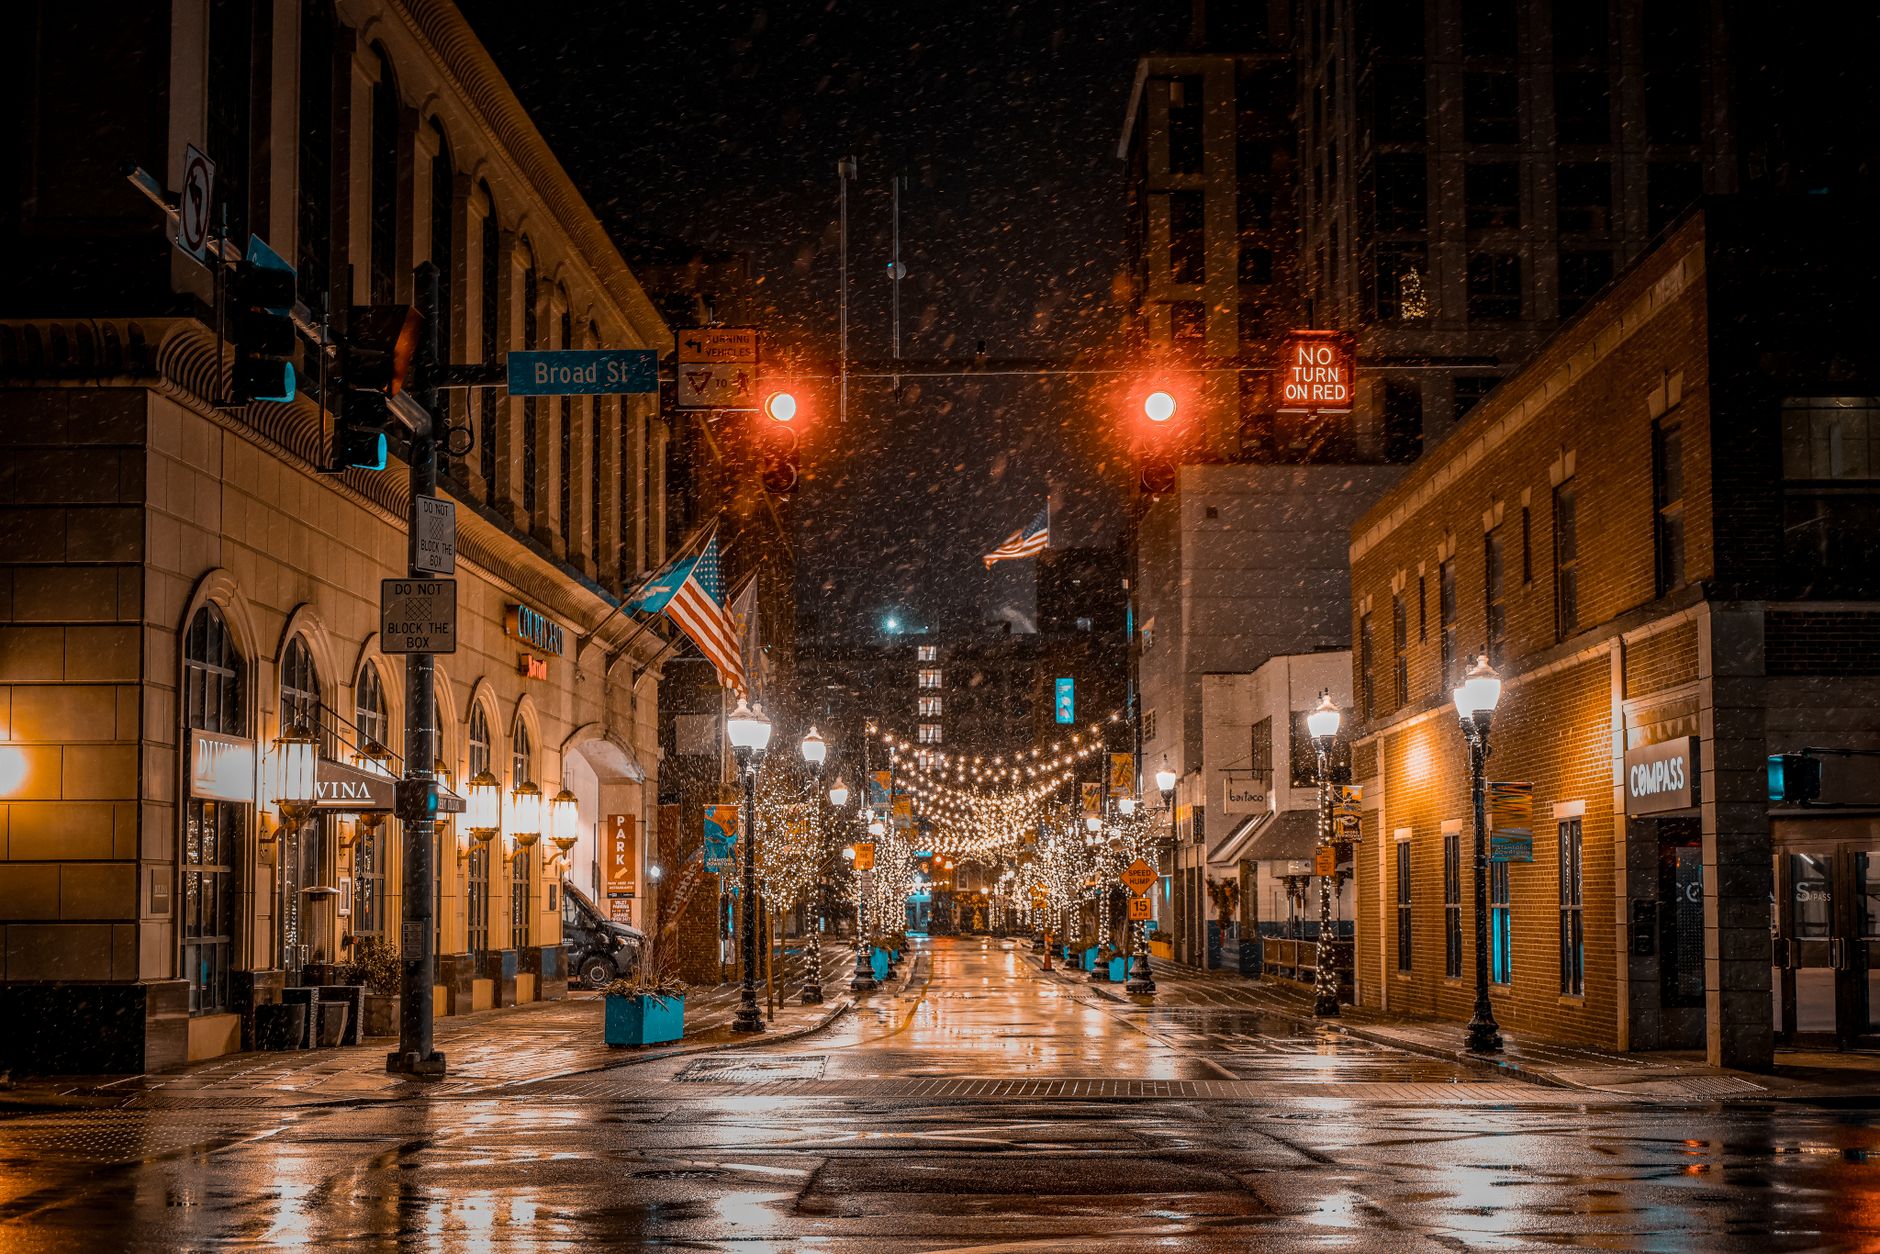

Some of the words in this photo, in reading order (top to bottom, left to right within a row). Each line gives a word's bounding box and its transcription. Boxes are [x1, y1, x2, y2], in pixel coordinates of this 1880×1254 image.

[706, 334, 750, 344] TURNING
[705, 347, 751, 357] VEHICLES
[1298, 347, 1332, 365] NO
[534, 361, 597, 384] Broad
[607, 360, 629, 383] St
[1292, 367, 1339, 382] TURN
[715, 378, 728, 388] TO
[1285, 384, 1308, 400] ON
[1313, 384, 1346, 400] RED
[423, 501, 433, 513] DO
[435, 503, 449, 517] NOT
[420, 539, 440, 553] BLOCK
[442, 543, 453, 556] THE
[429, 554, 442, 568] BOX
[394, 583, 412, 595] DO
[417, 583, 443, 595] NOT
[387, 622, 423, 634] BLOCK
[428, 622, 449, 634] THE
[406, 637, 430, 649] BOX
[1630, 756, 1685, 798] COMPASS
[1229, 789, 1264, 802] bartaco
[615, 815, 626, 865] PARK
[1128, 869, 1151, 877] SPEED
[1133, 900, 1148, 912] 15
